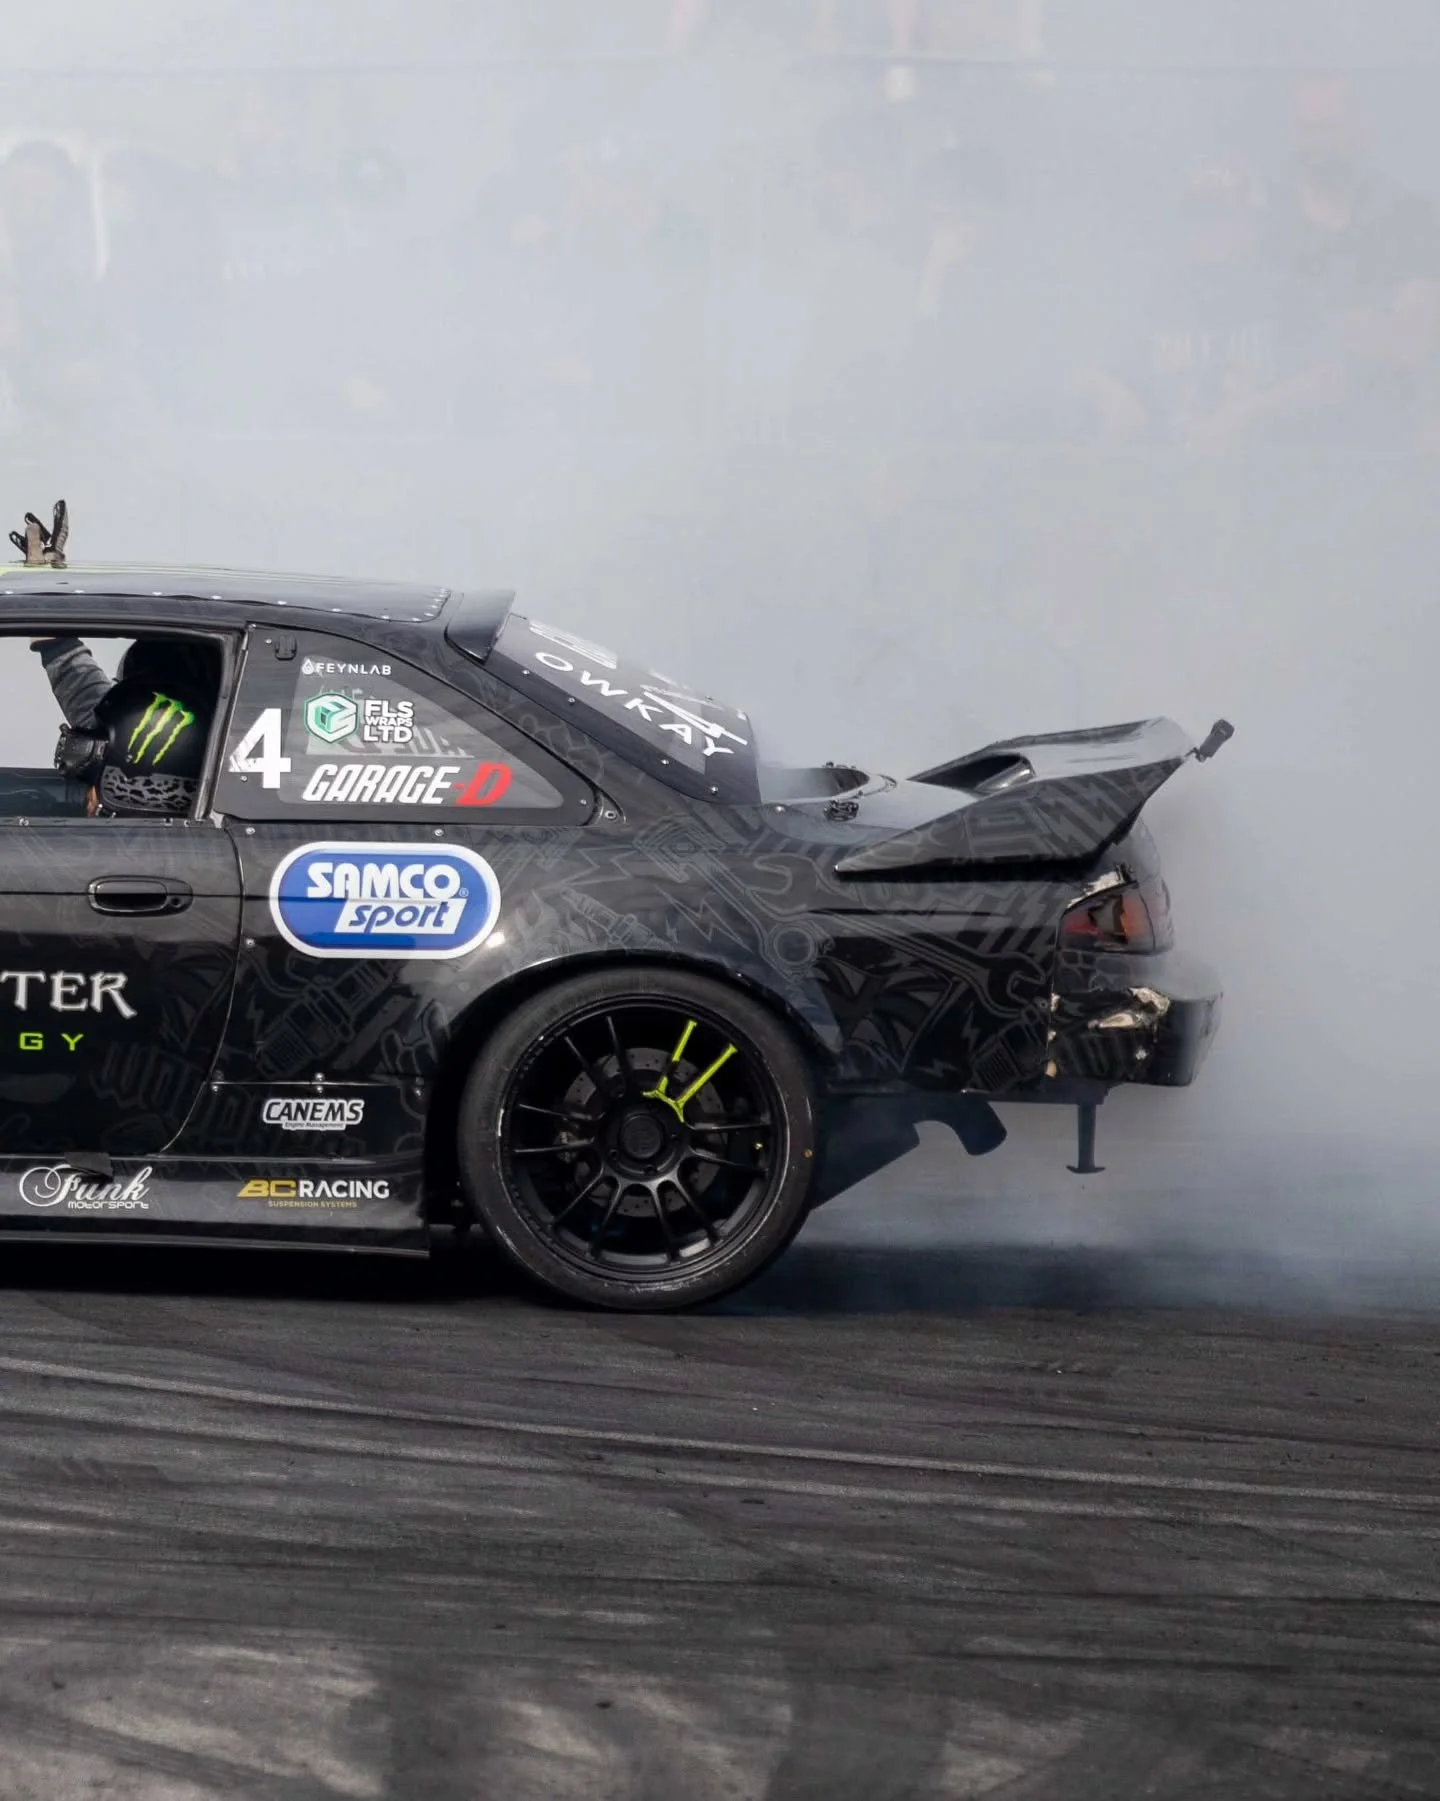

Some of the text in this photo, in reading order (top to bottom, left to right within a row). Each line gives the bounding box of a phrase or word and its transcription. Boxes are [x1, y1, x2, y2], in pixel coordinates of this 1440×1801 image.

[315, 662, 392, 676] FEYNLAB
[364, 700, 414, 718] FLS
[365, 717, 413, 727] WRAPS
[363, 727, 414, 743] LTD
[228, 708, 291, 789] 4
[306, 862, 461, 899] SAMCO
[348, 901, 451, 934] sport
[0, 970, 138, 1019] TER
[265, 1101, 363, 1121] CANEMS
[19, 1163, 153, 1207] Funk
[267, 1200, 358, 1208] SUSPENSION SYSTEMS
